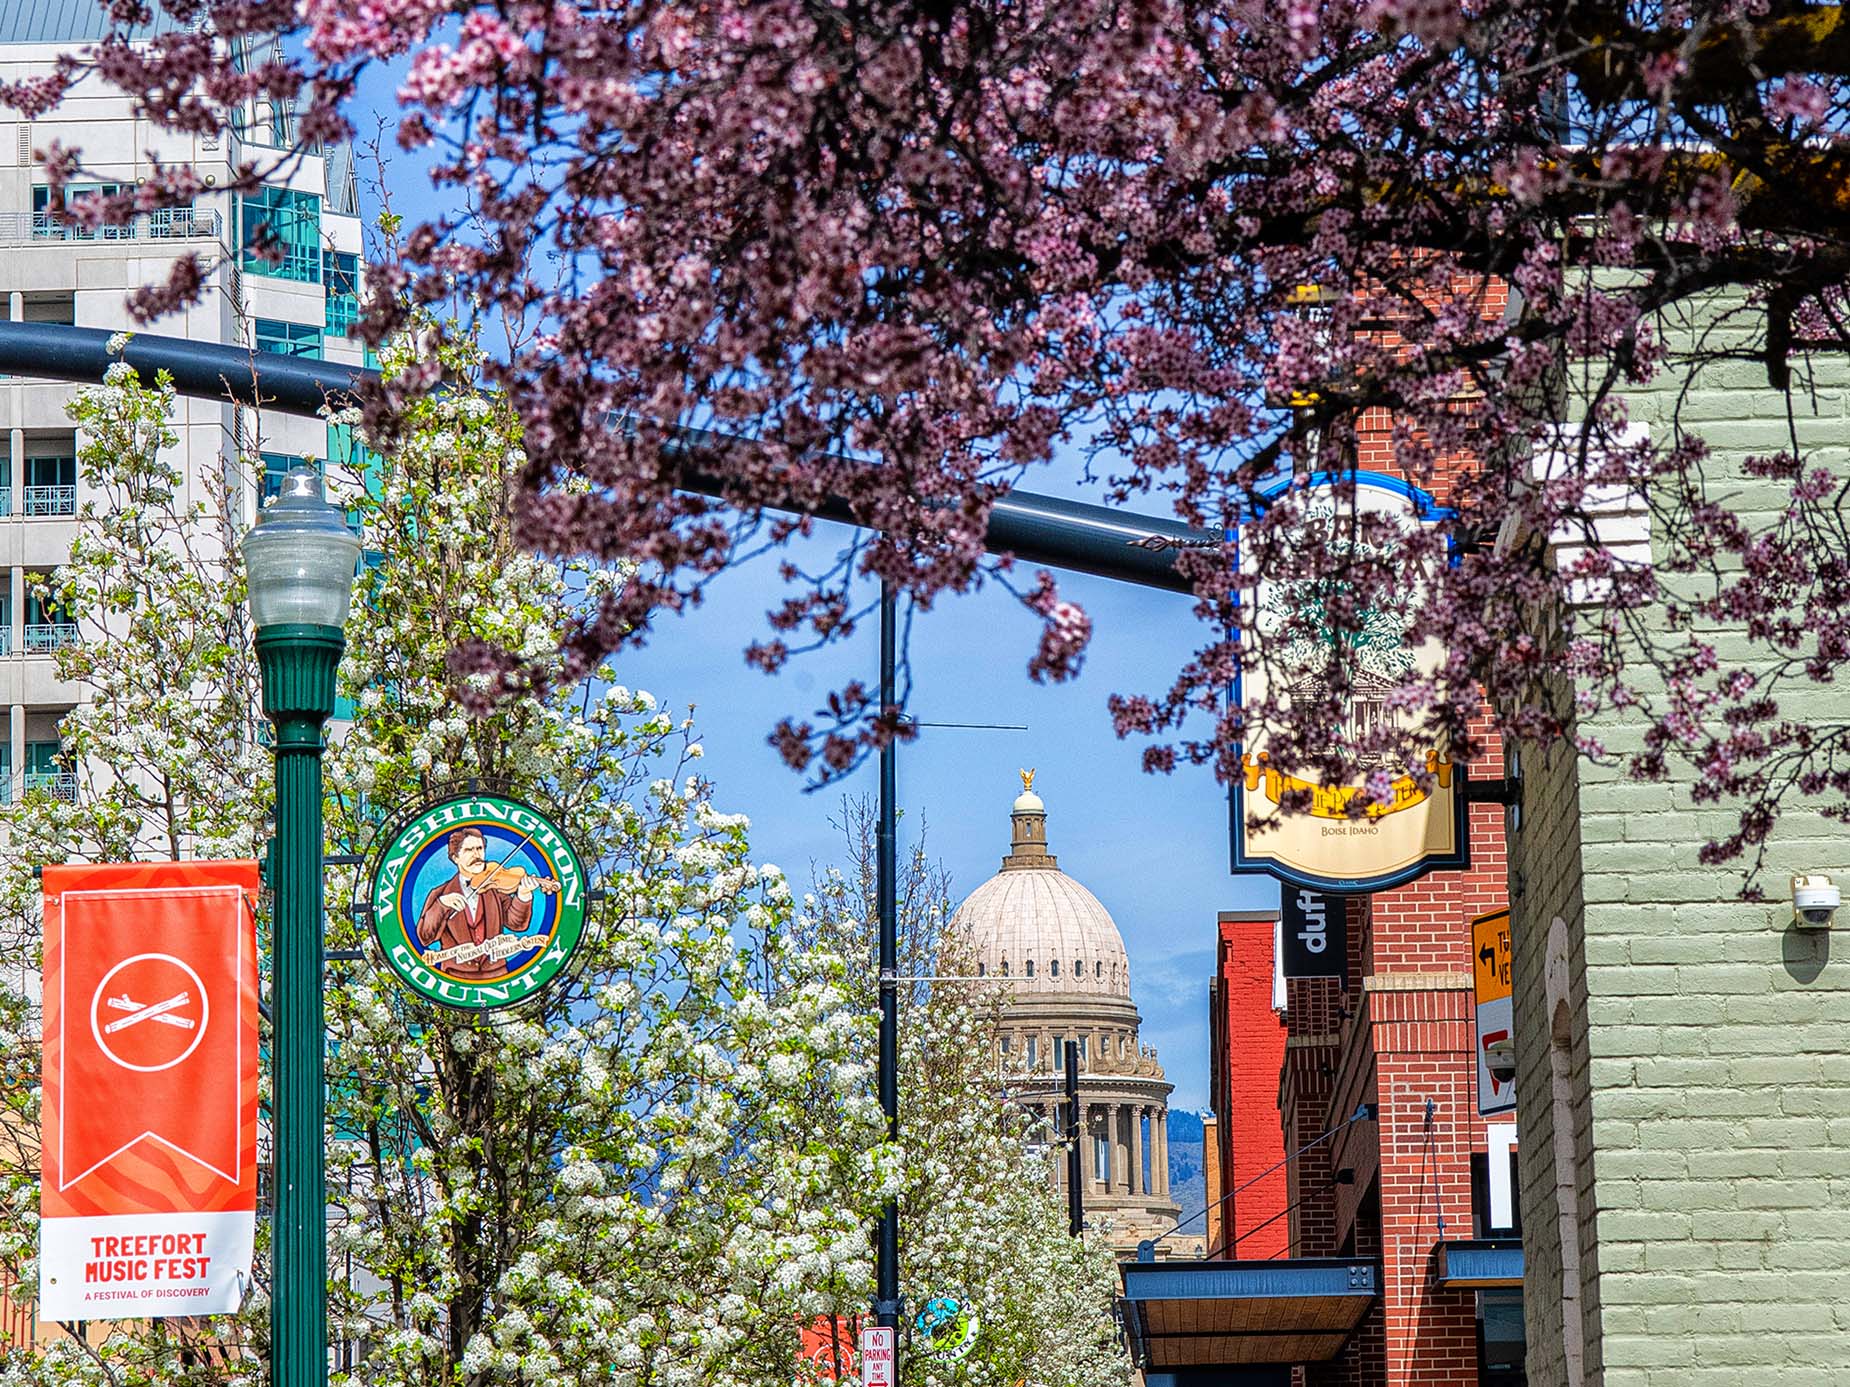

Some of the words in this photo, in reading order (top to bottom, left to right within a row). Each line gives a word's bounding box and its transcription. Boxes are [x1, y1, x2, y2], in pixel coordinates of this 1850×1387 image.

[1321, 826, 1347, 836] BOISE
[1349, 826, 1379, 836] IDAHO
[377, 801, 581, 922] WASHINGTON
[423, 951, 449, 964] HOME
[391, 935, 568, 1003] COUNTY
[91, 1233, 206, 1258] TREEFORT
[85, 1260, 147, 1283] MUSIC
[154, 1257, 211, 1280] FEST
[85, 1293, 91, 1301] A
[94, 1290, 138, 1300] FESTIVAL
[141, 1289, 153, 1298] OF
[156, 1287, 210, 1298] DISCOVERY
[871, 1334, 884, 1346] NO
[865, 1348, 891, 1361] PARKING
[872, 1363, 883, 1372] ANY
[871, 1372, 884, 1381] TIME
